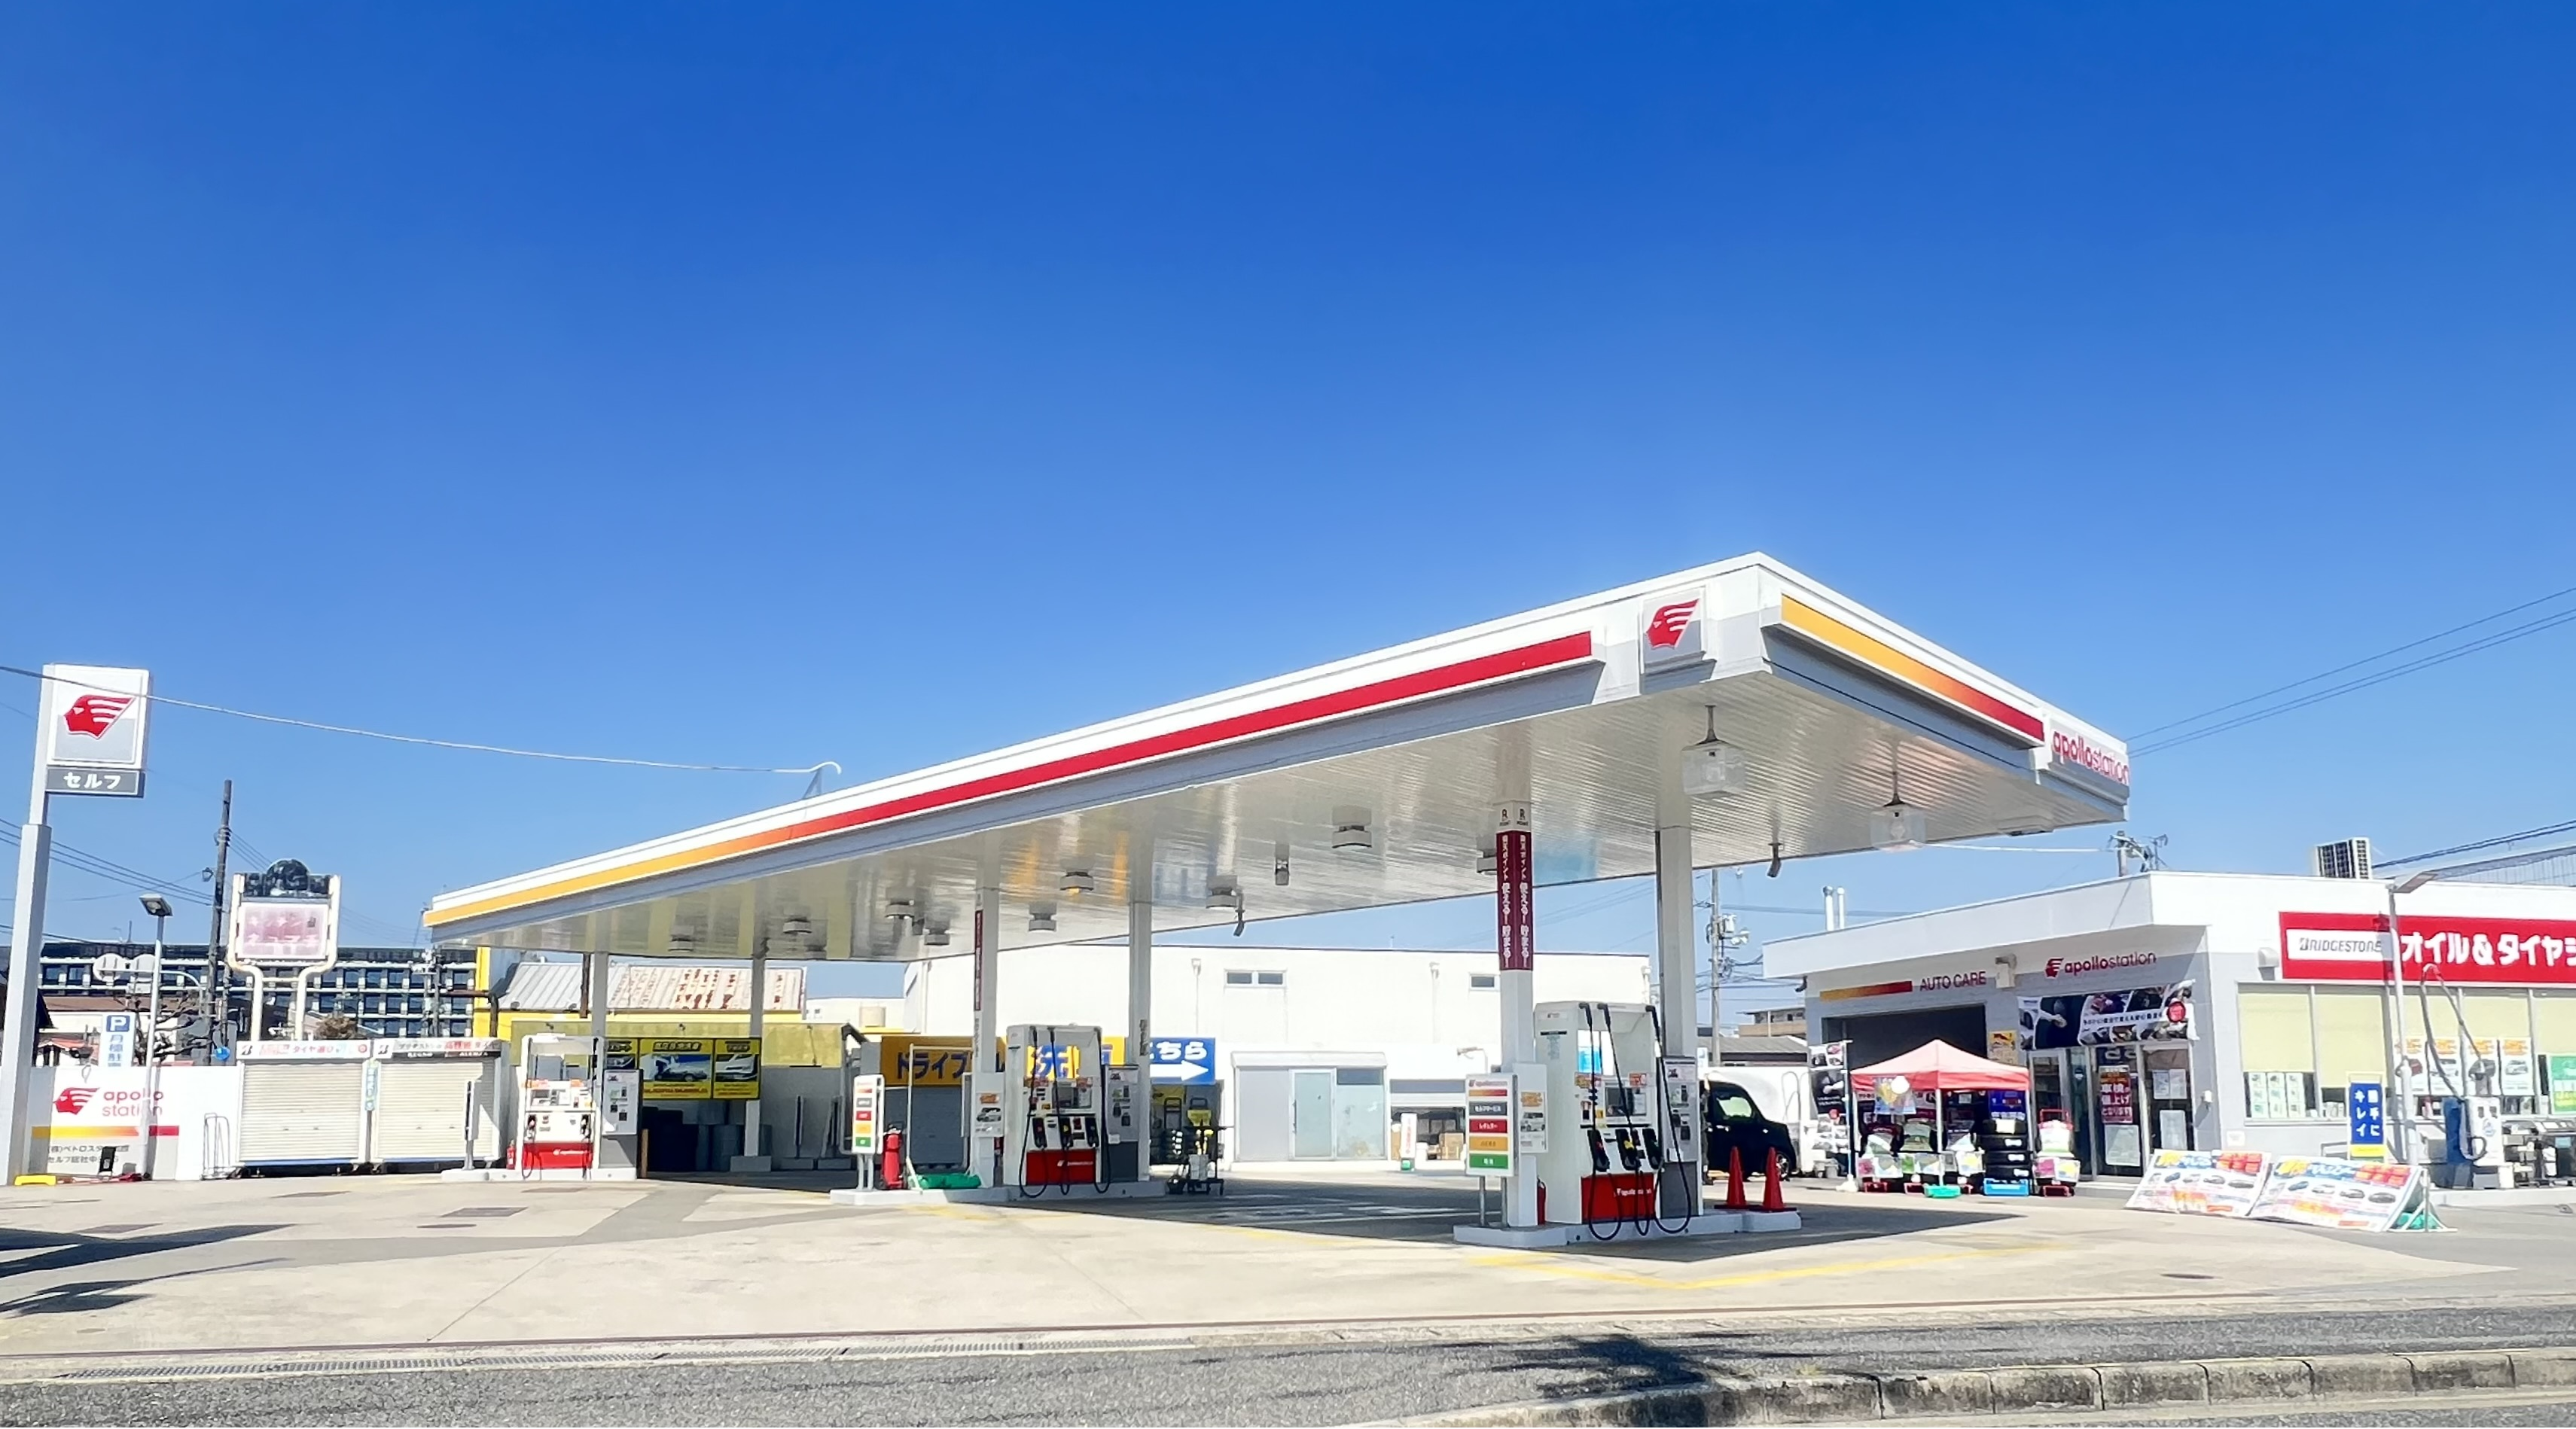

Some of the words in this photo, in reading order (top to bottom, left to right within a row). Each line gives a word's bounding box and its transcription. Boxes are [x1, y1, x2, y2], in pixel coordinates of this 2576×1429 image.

[2053, 731, 2129, 785] apollostation
[64, 772, 121, 790] セルフ
[2299, 937, 2382, 952] BRIDGESTONE
[2064, 950, 2157, 977] apollostation
[1919, 976, 1950, 991] AUTO
[1953, 970, 1986, 989] CARE
[110, 1017, 127, 1031] P
[897, 1051, 1006, 1079] ドライブ
[102, 1102, 163, 1117] statin
[2354, 1089, 2367, 1137] キレイ
